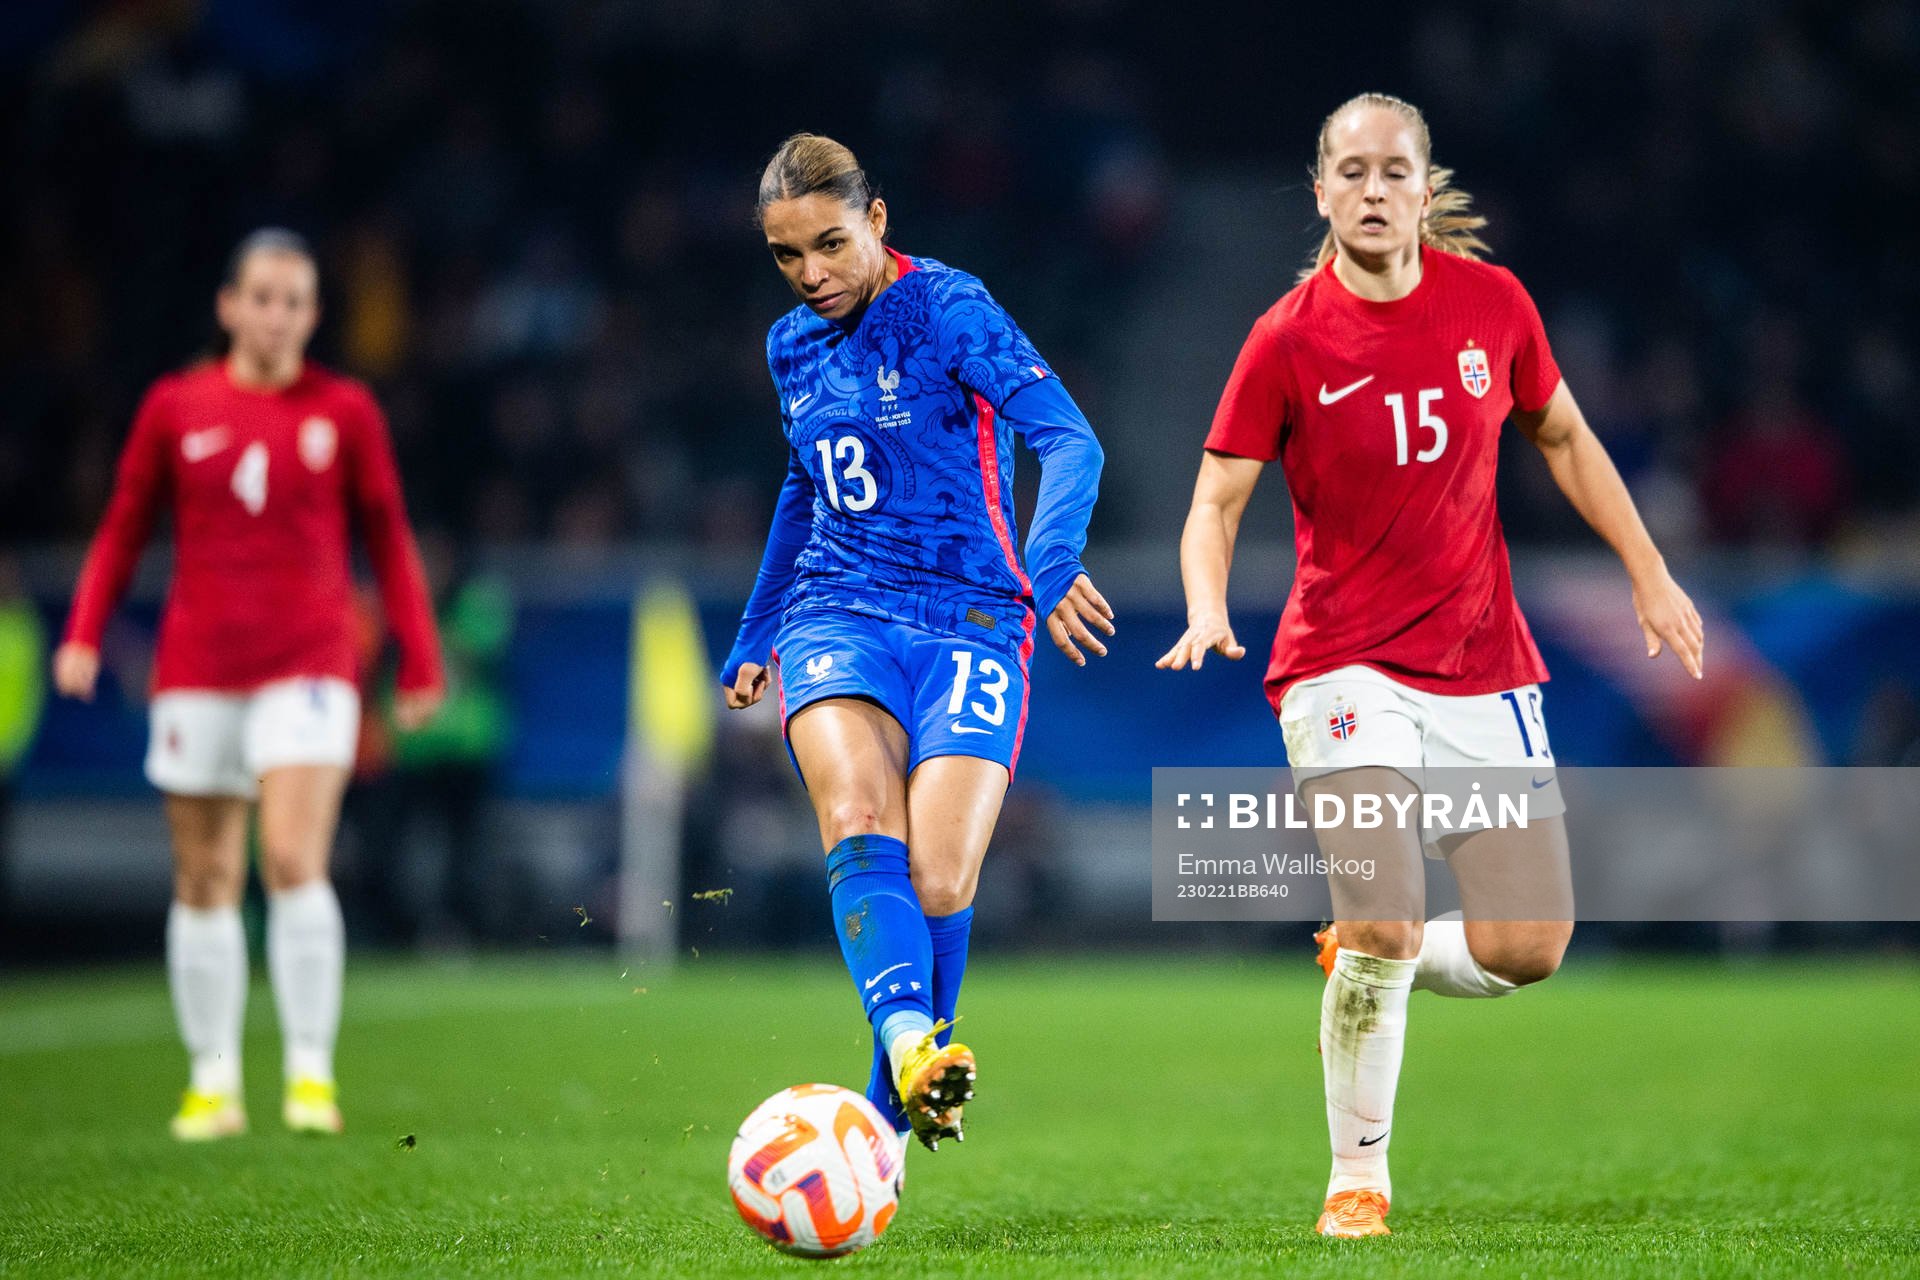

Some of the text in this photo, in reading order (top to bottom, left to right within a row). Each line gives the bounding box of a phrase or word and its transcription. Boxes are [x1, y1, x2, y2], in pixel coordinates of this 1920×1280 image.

[1384, 387, 1449, 466] 15
[229, 440, 270, 517] 4
[816, 435, 878, 512] 13
[946, 650, 1009, 727] 13
